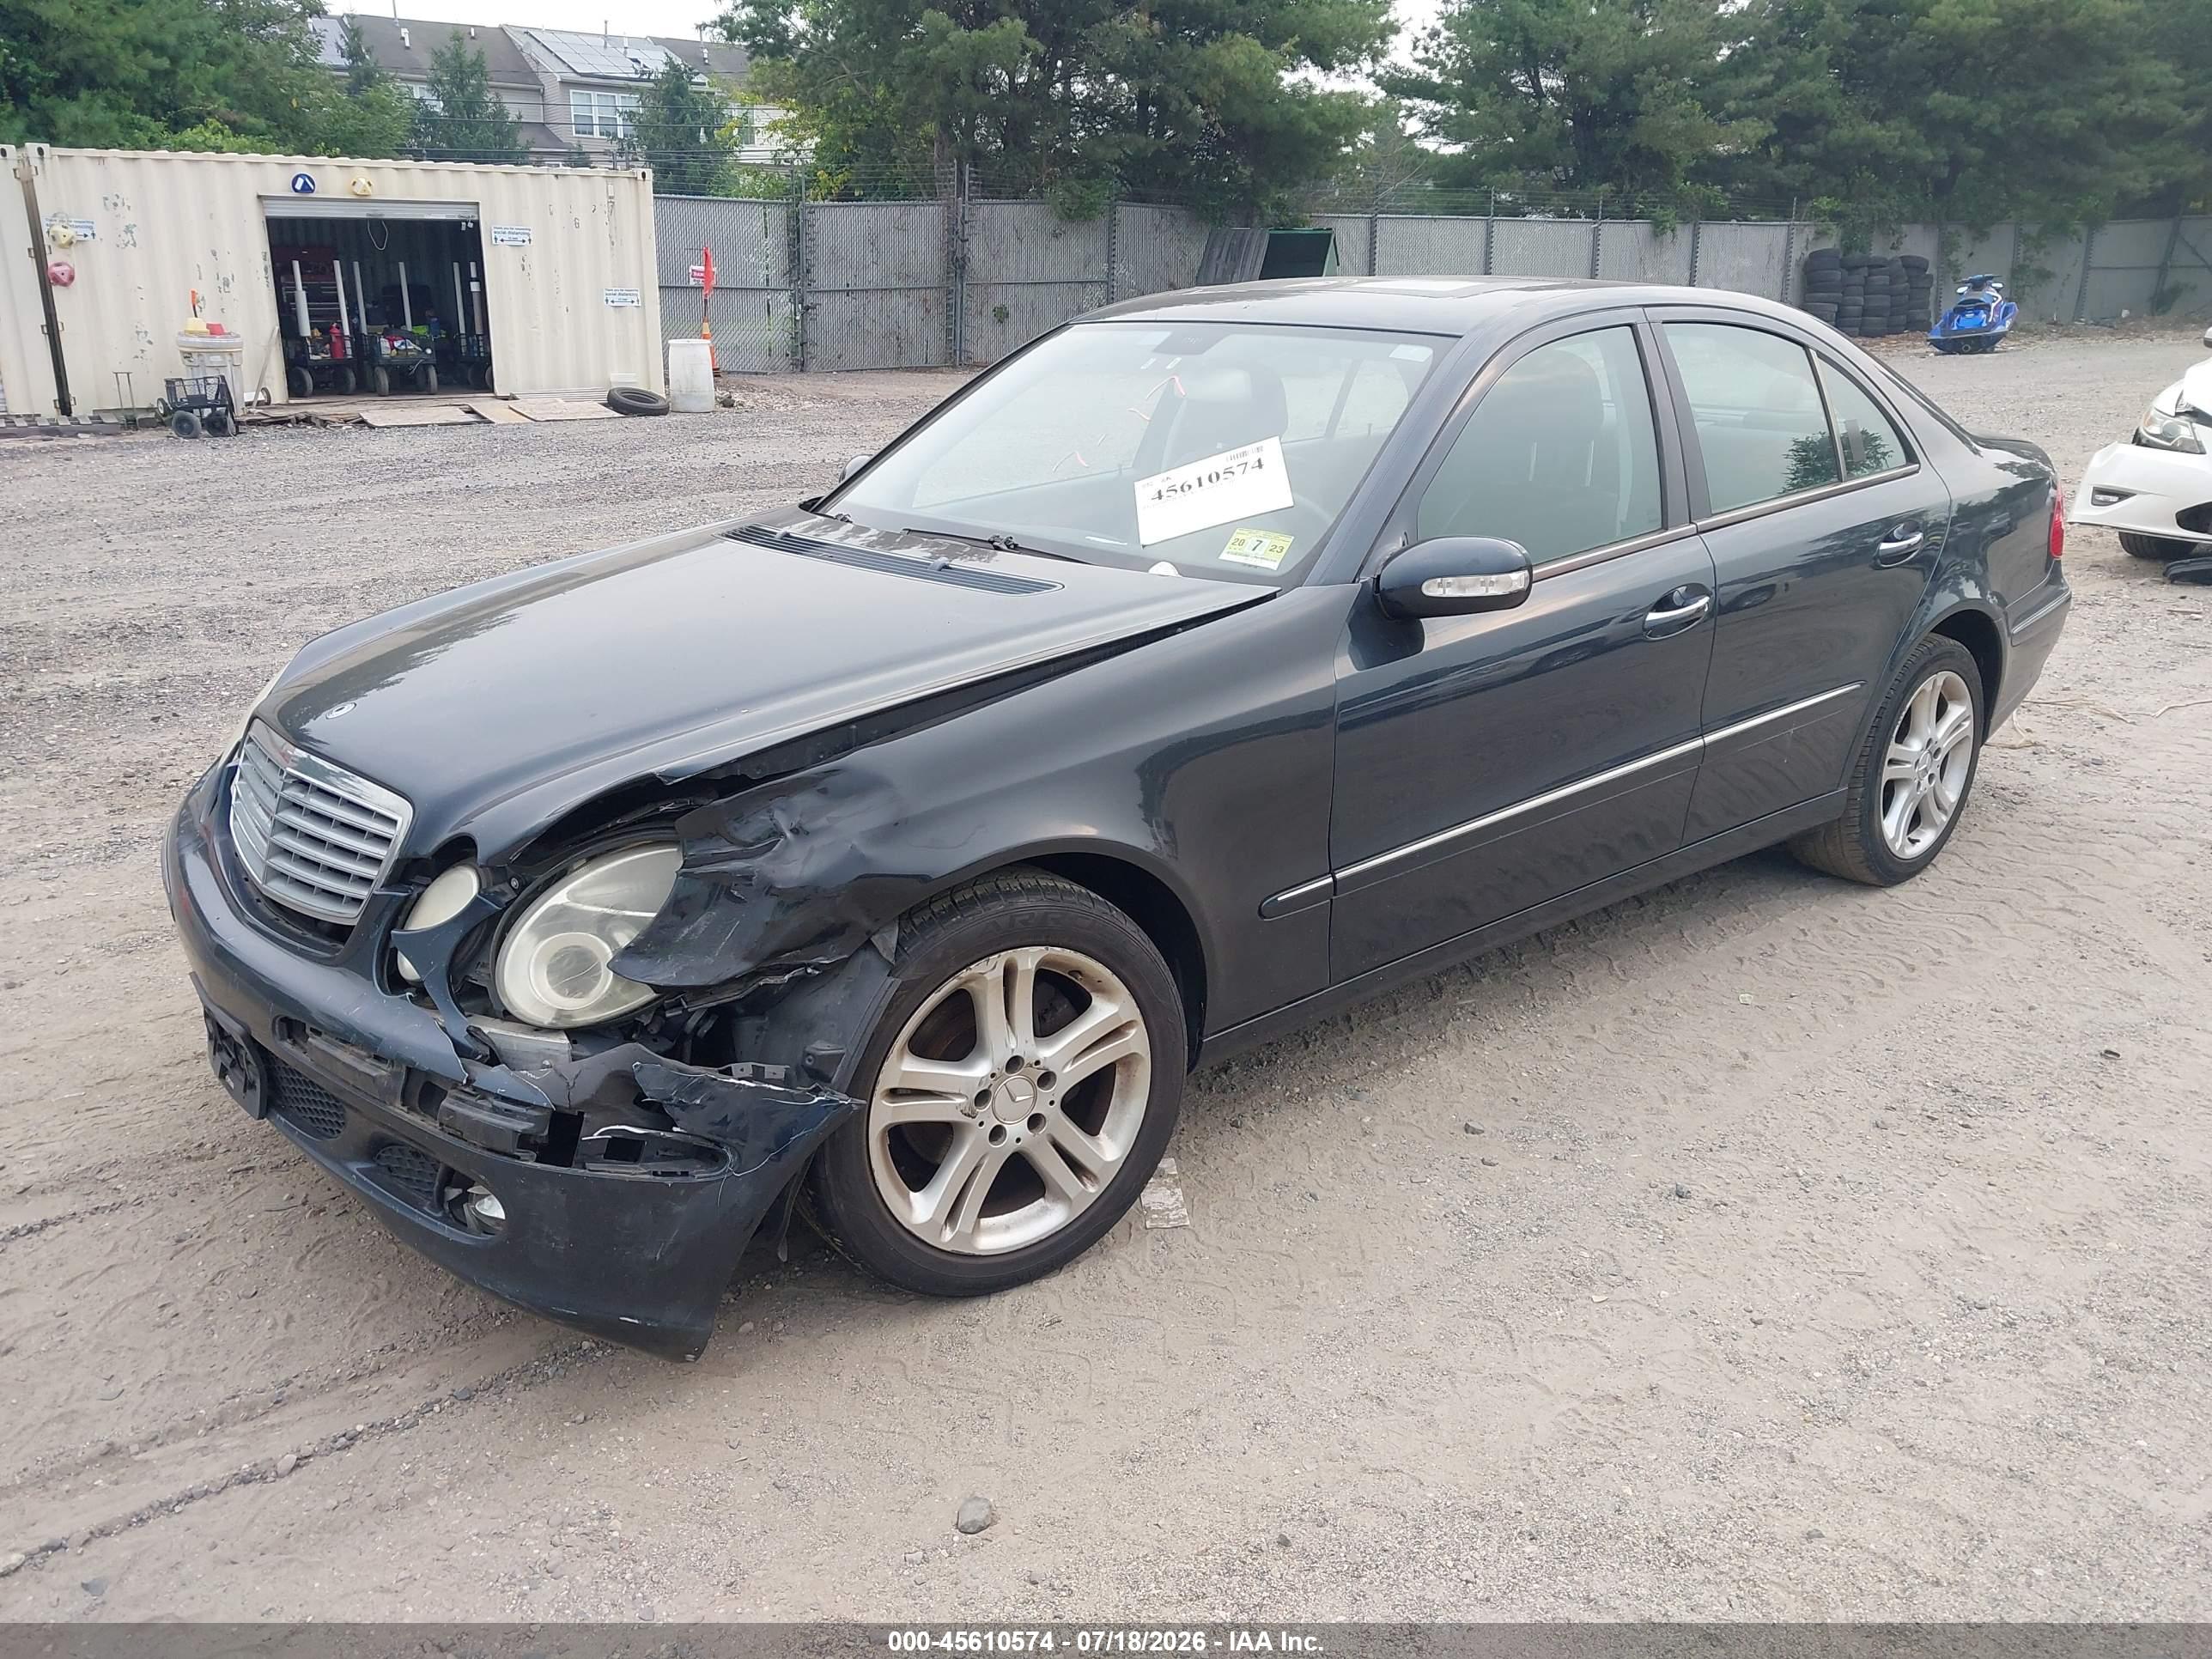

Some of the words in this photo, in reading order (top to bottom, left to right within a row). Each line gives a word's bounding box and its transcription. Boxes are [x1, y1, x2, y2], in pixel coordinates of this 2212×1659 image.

[1152, 457, 1266, 501] 45610574
[1231, 538, 1245, 547] 20
[1251, 539, 1263, 551] 7
[1268, 544, 1285, 554] 23
